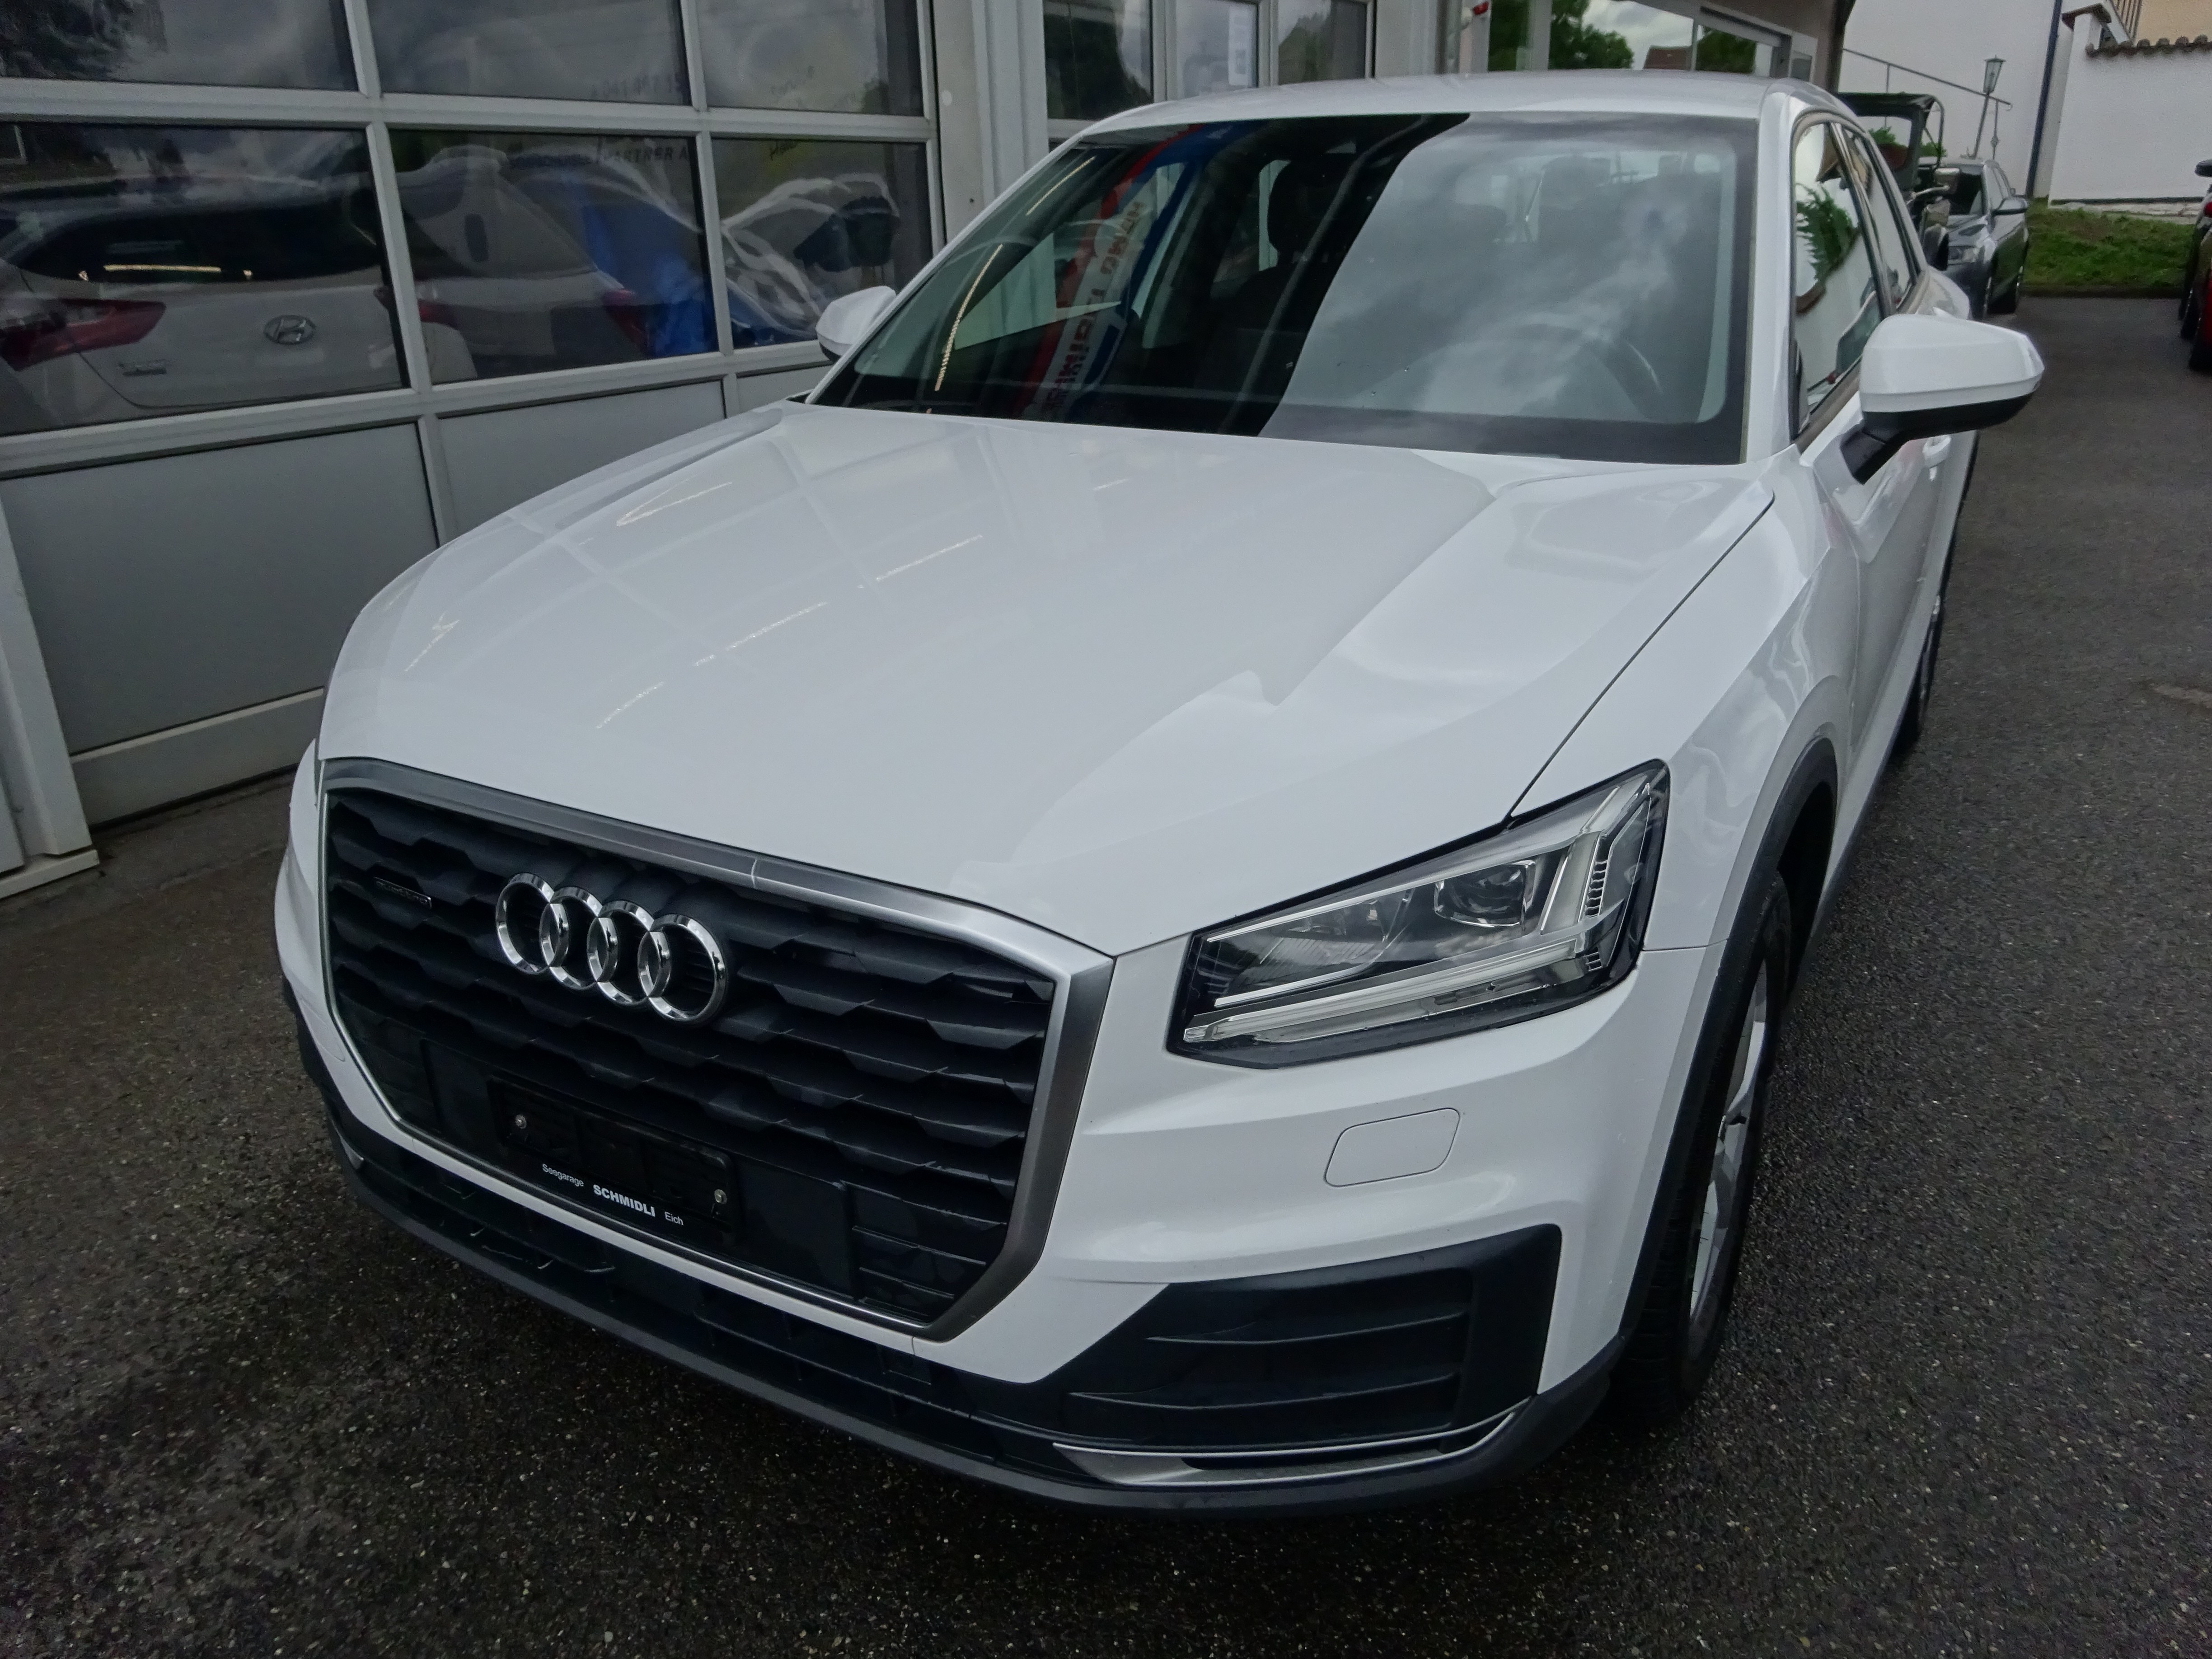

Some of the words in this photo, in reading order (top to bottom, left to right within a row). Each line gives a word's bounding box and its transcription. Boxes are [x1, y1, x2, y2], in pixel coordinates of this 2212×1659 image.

[542, 1163, 584, 1187] Seegarage
[593, 1184, 656, 1217] SCHMIDLI
[664, 1211, 684, 1226] Eich
